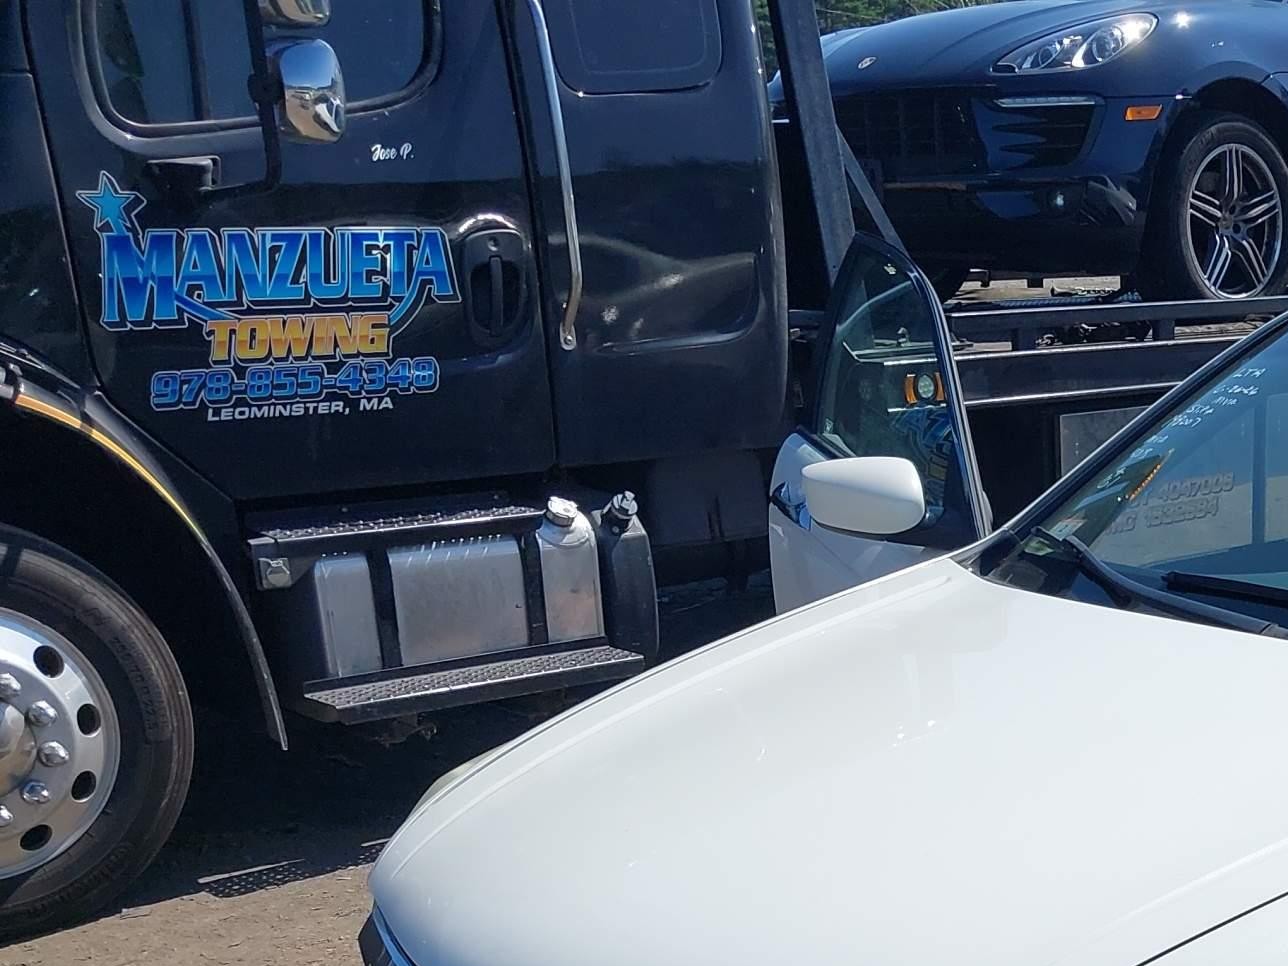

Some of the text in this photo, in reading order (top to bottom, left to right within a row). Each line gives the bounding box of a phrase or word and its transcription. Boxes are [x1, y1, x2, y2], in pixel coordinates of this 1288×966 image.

[101, 226, 461, 331] MANZUETA
[205, 313, 393, 366] TOWING
[151, 357, 440, 411] 978-855-4348
[207, 397, 394, 421] LEOMINSTER, MA
